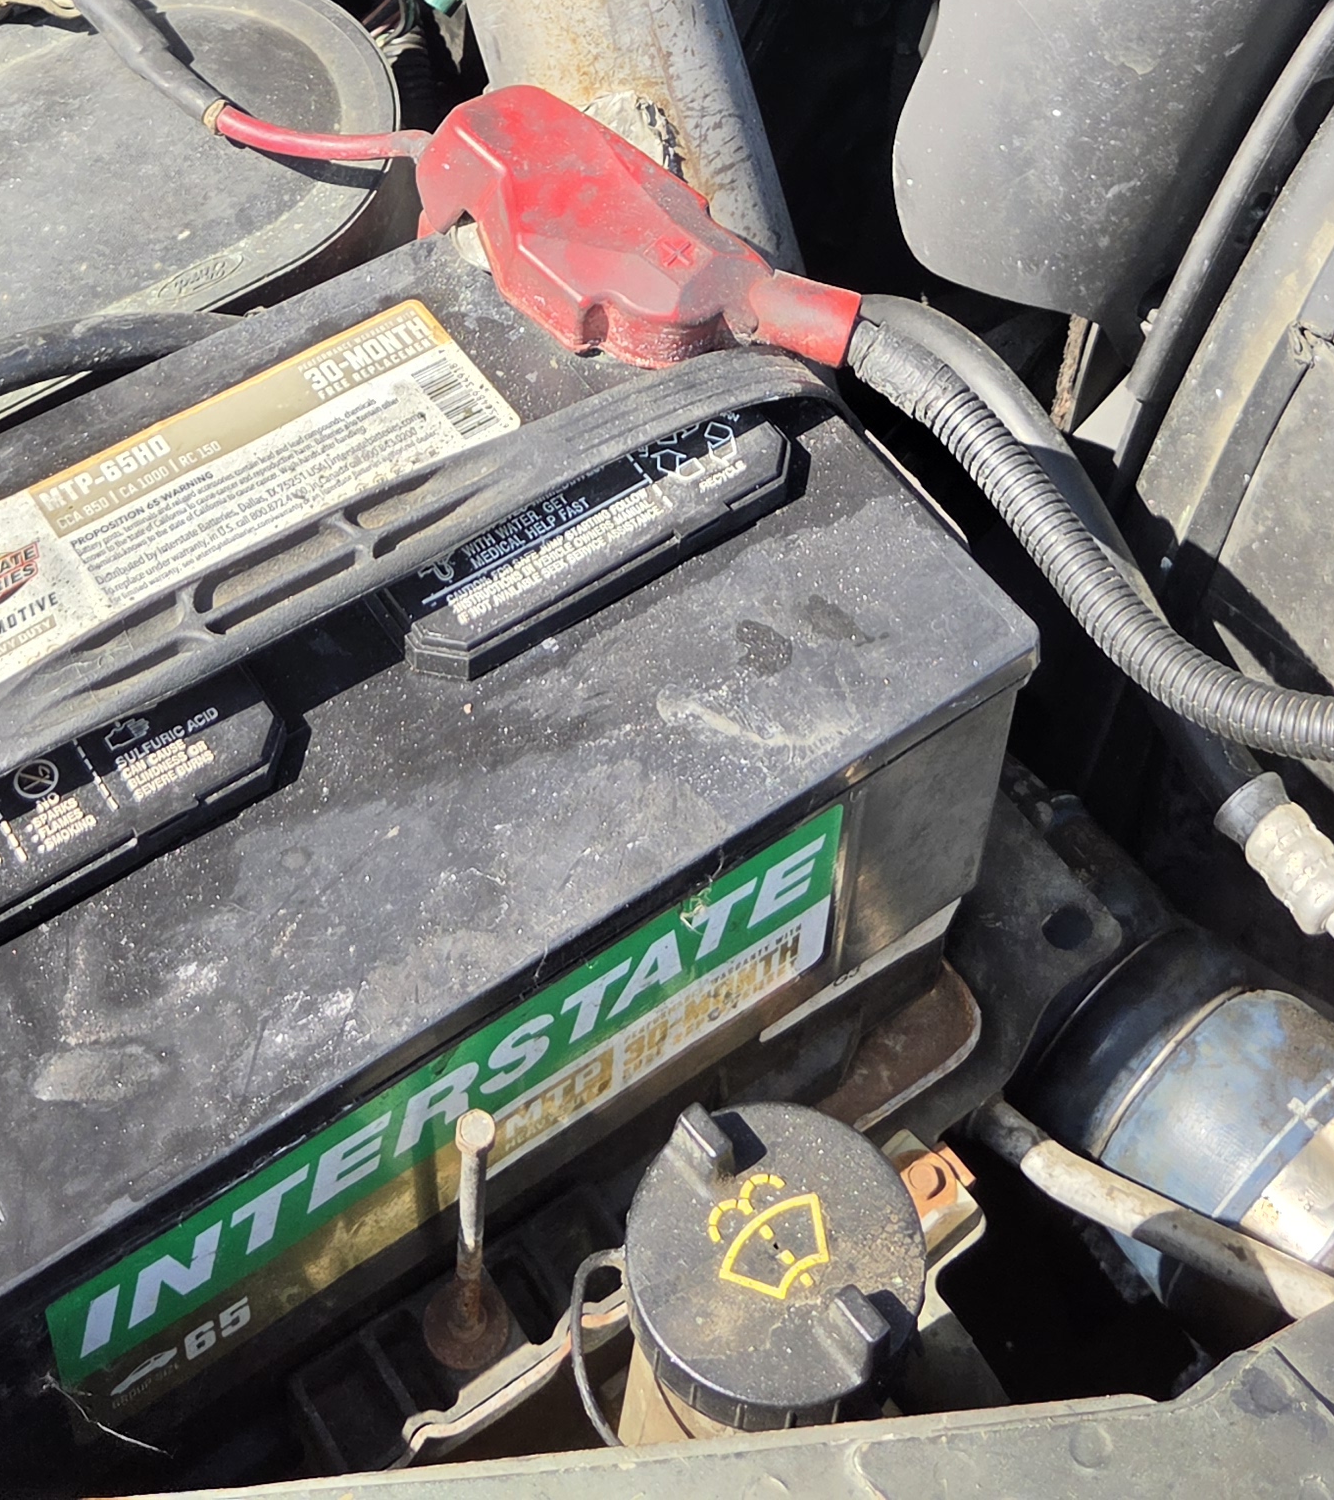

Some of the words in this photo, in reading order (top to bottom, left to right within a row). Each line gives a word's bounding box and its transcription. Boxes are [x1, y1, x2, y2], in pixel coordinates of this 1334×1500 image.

[296, 341, 353, 371] PERFORMANCE
[301, 315, 432, 391] 30-MONTH
[316, 377, 351, 400] FREE
[37, 433, 172, 512] MTP-65HD
[55, 509, 84, 529] CCA
[81, 496, 110, 516] 850
[117, 481, 139, 498] CA
[136, 465, 171, 488] 1000
[177, 451, 198, 467] RC
[196, 439, 222, 458] 150
[121, 510, 158, 532] terminals
[155, 503, 172, 515] and
[170, 490, 197, 507] related
[195, 471, 235, 495] accessories
[232, 458, 260, 476] contain
[257, 450, 275, 464] lead
[273, 443, 289, 455] and
[286, 435, 304, 448] lead
[341, 397, 377, 419] chemicals
[698, 458, 747, 492] RECYCLE
[70, 505, 145, 548] PROPOSITION
[145, 497, 161, 509] 65
[160, 471, 214, 501] WARNING
[94, 554, 146, 586] Distributed
[143, 547, 159, 563] by
[156, 527, 199, 553] Interstate
[196, 506, 239, 533] Batteries,
[237, 491, 269, 513] Dallas,
[265, 486, 278, 497] TX
[276, 472, 307, 491] 75251
[305, 461, 327, 477] USA
[101, 584, 115, 596] To
[112, 569, 147, 592] replace
[143, 556, 171, 575] under
[168, 536, 211, 563] warranty,
[233, 514, 251, 527] call
[316, 463, 351, 485] Canada
[346, 455, 363, 468] call
[113, 536, 128, 547] the
[126, 527, 146, 541] state
[152, 505, 188, 527] California
[195, 492, 216, 506] cause
[214, 480, 239, 496] cancer
[237, 473, 253, 484] and
[251, 451, 296, 478] reproductive
[154, 527, 168, 537] the
[167, 518, 186, 531] state
[192, 495, 228, 517] California
[234, 482, 256, 497] cause
[461, 531, 496, 559] WITH
[542, 492, 568, 515] GET
[469, 531, 526, 570] MEDICAL
[524, 514, 557, 541] HELP
[558, 495, 589, 522] FAST
[450, 569, 523, 615] INSTRUCTIONS
[521, 562, 536, 577] IN
[533, 540, 573, 570] VEHICLE
[573, 518, 614, 548] OWNERS
[490, 561, 513, 582] FOR
[512, 548, 538, 570] SAFE
[536, 533, 565, 556] JUMP
[563, 507, 611, 541] STARTING
[608, 487, 648, 516] FOLLOW
[119, 580, 149, 599] limited
[456, 609, 470, 625] IF
[467, 597, 492, 620] NOT
[492, 570, 543, 607] AVAILABLE
[540, 557, 568, 579] SEEK
[566, 535, 606, 565] SERVICE
[17, 617, 53, 643] DUTY
[114, 724, 185, 769] SULFURIC
[186, 705, 219, 732] ACID
[120, 759, 146, 781] CAN
[147, 738, 186, 767] CAUSE
[126, 749, 188, 791] BLINDNESS
[186, 738, 208, 758] OR
[34, 790, 60, 814] NO
[133, 769, 176, 801] SEVERE
[176, 748, 216, 777] BURNS
[32, 796, 78, 830] SPARKS
[38, 807, 84, 841] FLAMES
[44, 812, 97, 851] SMOKING
[622, 932, 801, 1067] 30-MONTH
[80, 832, 826, 1359] INTERSTATE
[504, 1059, 602, 1139] MTP
[182, 1295, 252, 1362] 65
